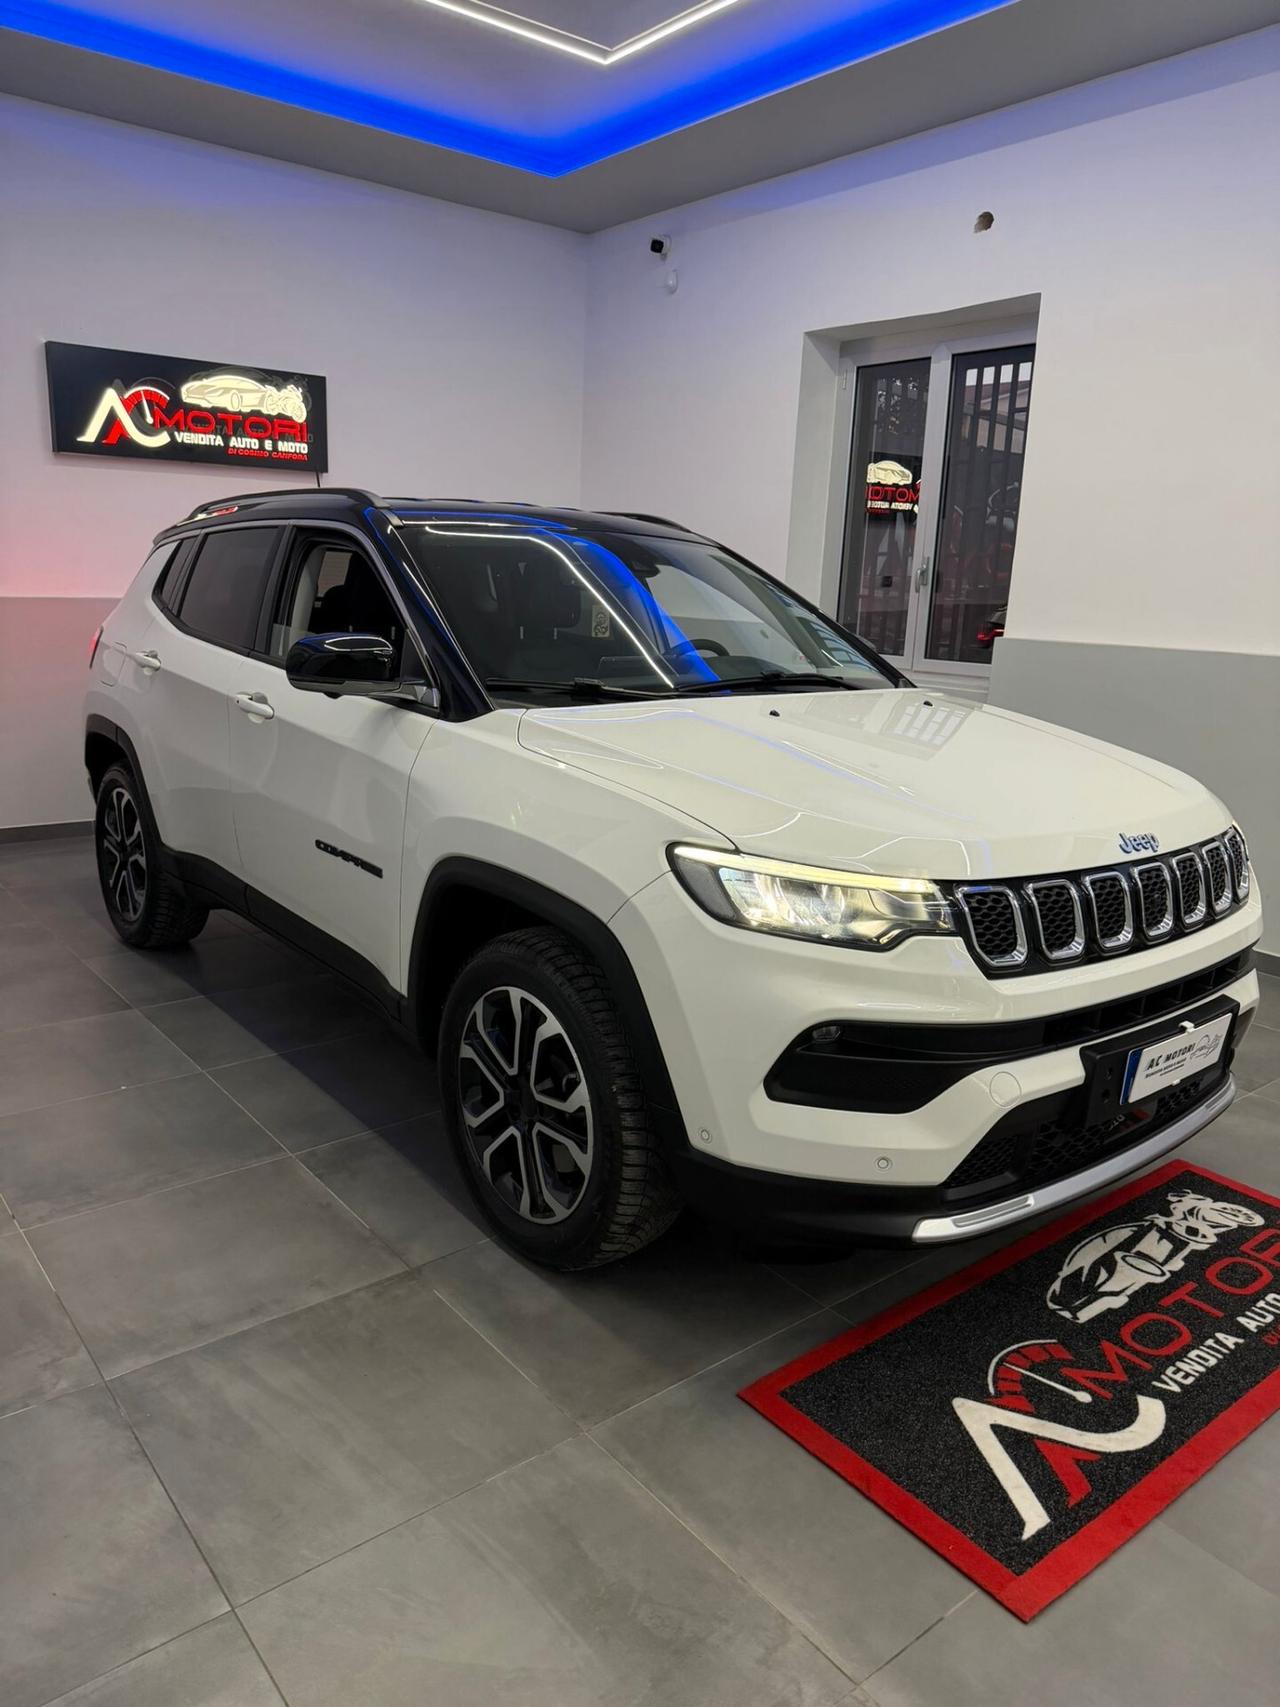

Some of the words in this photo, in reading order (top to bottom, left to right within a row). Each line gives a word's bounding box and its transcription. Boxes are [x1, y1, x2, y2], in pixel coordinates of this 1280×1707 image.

[153, 405, 309, 442] MOTORI
[174, 431, 225, 447] VENDITA
[229, 436, 259, 449] AUTO
[264, 439, 273, 451] E
[277, 441, 309, 454] MOTO
[1118, 832, 1160, 854] Jeep
[1163, 1042, 1196, 1063] MOTORI
[1060, 1220, 1280, 1400] MOTOR
[1151, 1331, 1245, 1393] VENDITA
